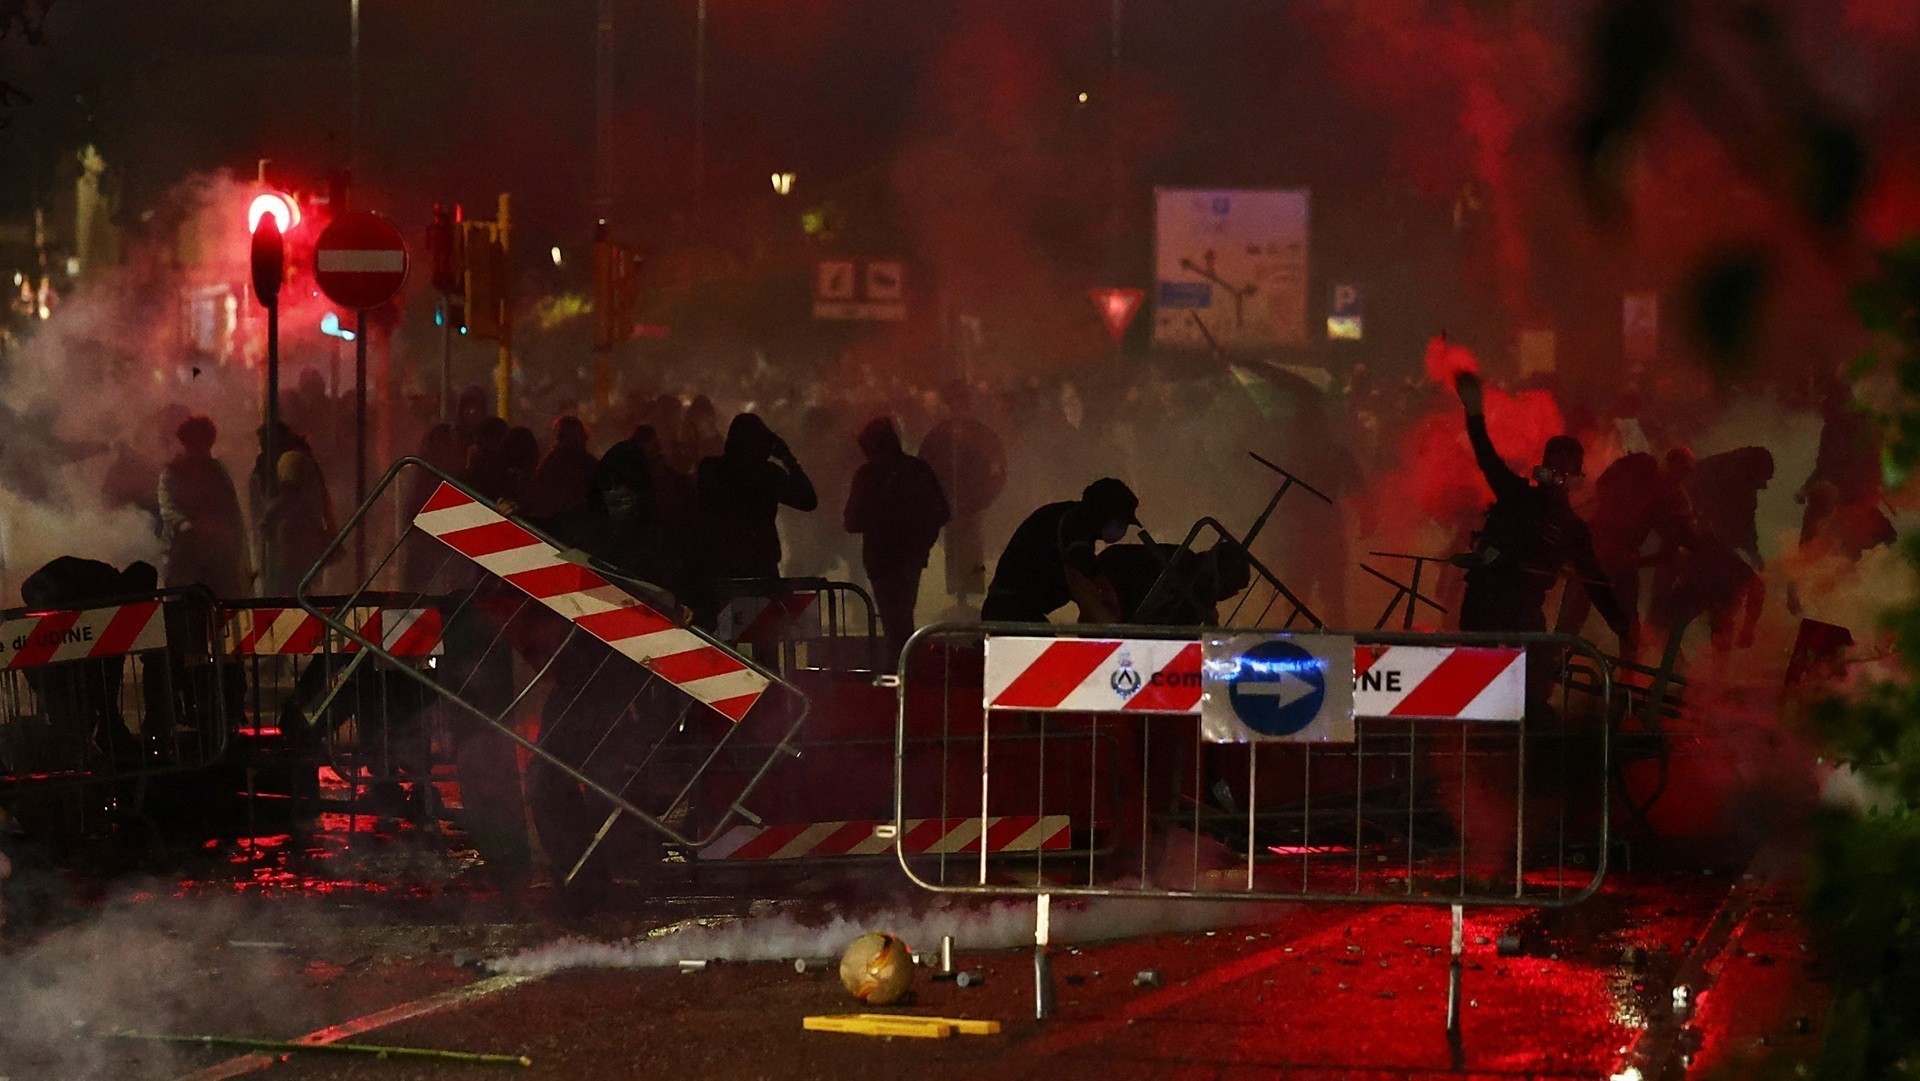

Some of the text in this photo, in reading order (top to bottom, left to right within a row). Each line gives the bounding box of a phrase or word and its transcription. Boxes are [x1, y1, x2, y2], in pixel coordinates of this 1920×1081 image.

[1335, 285, 1355, 311] P
[13, 635, 27, 650] di
[38, 626, 93, 646] UDINE
[1355, 670, 1401, 692] NE
